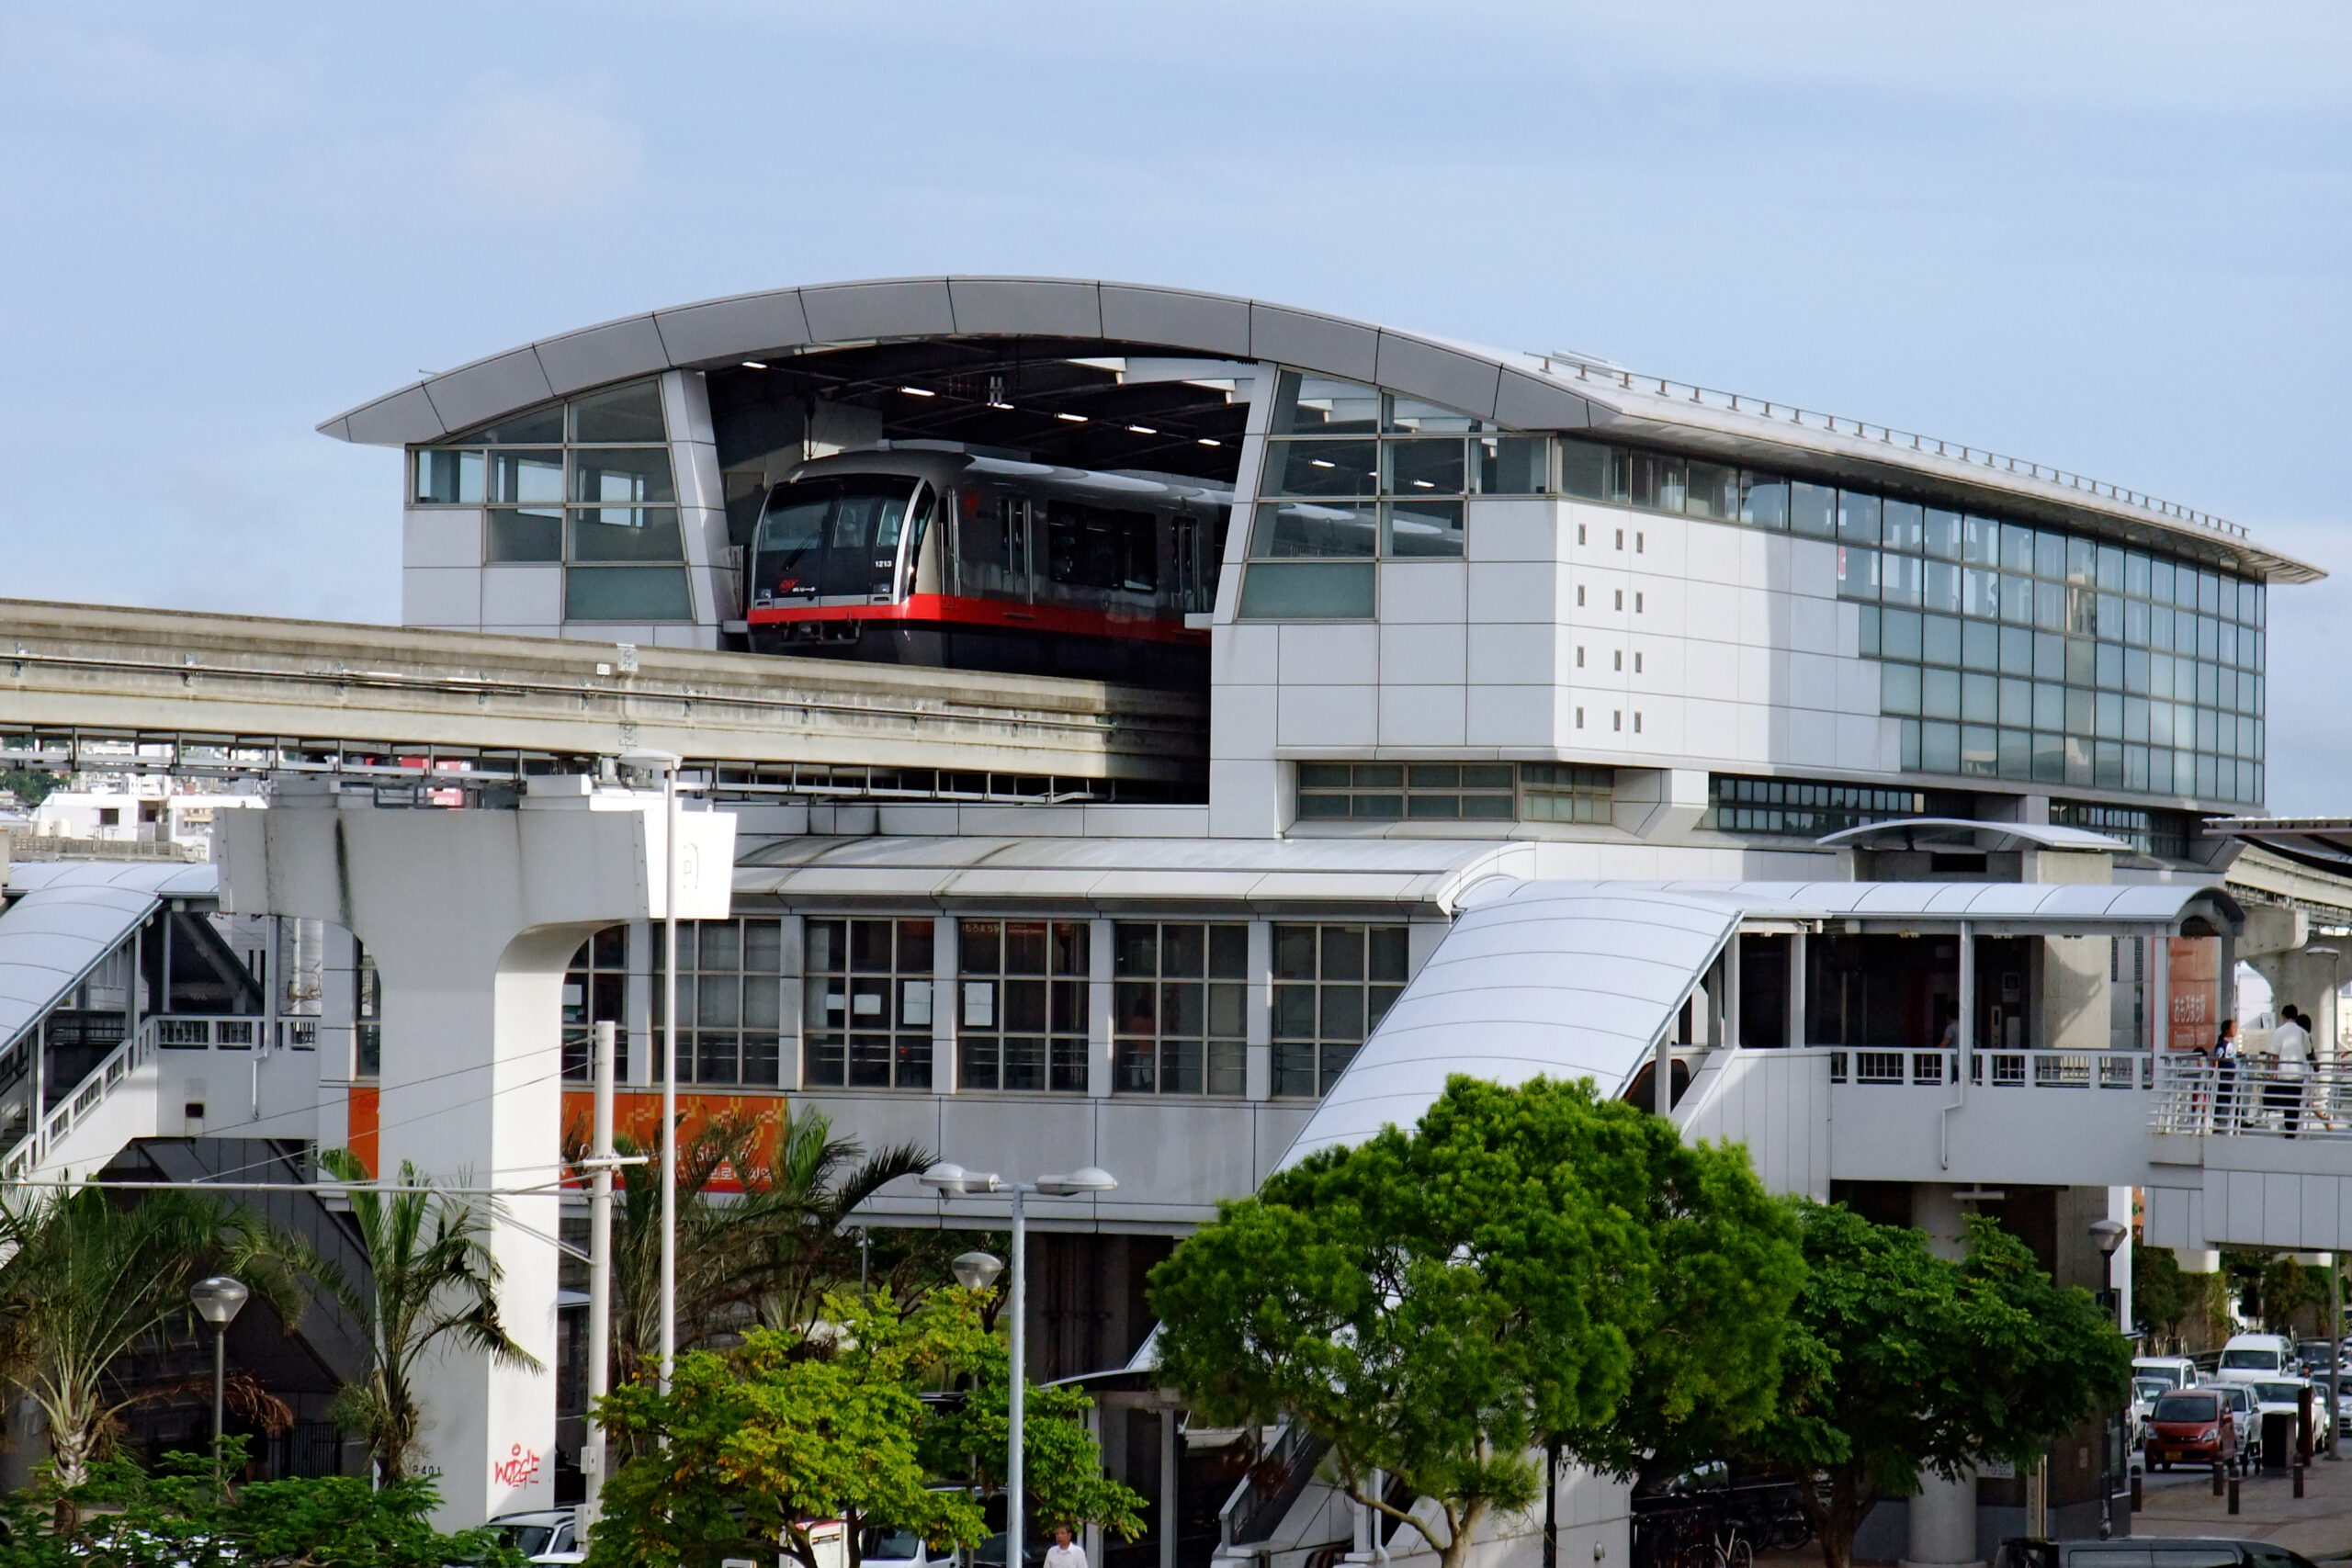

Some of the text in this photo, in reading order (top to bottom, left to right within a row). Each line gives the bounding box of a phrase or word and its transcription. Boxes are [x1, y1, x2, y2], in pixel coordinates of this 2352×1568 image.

[963, 923, 1001, 933] もろまち駅
